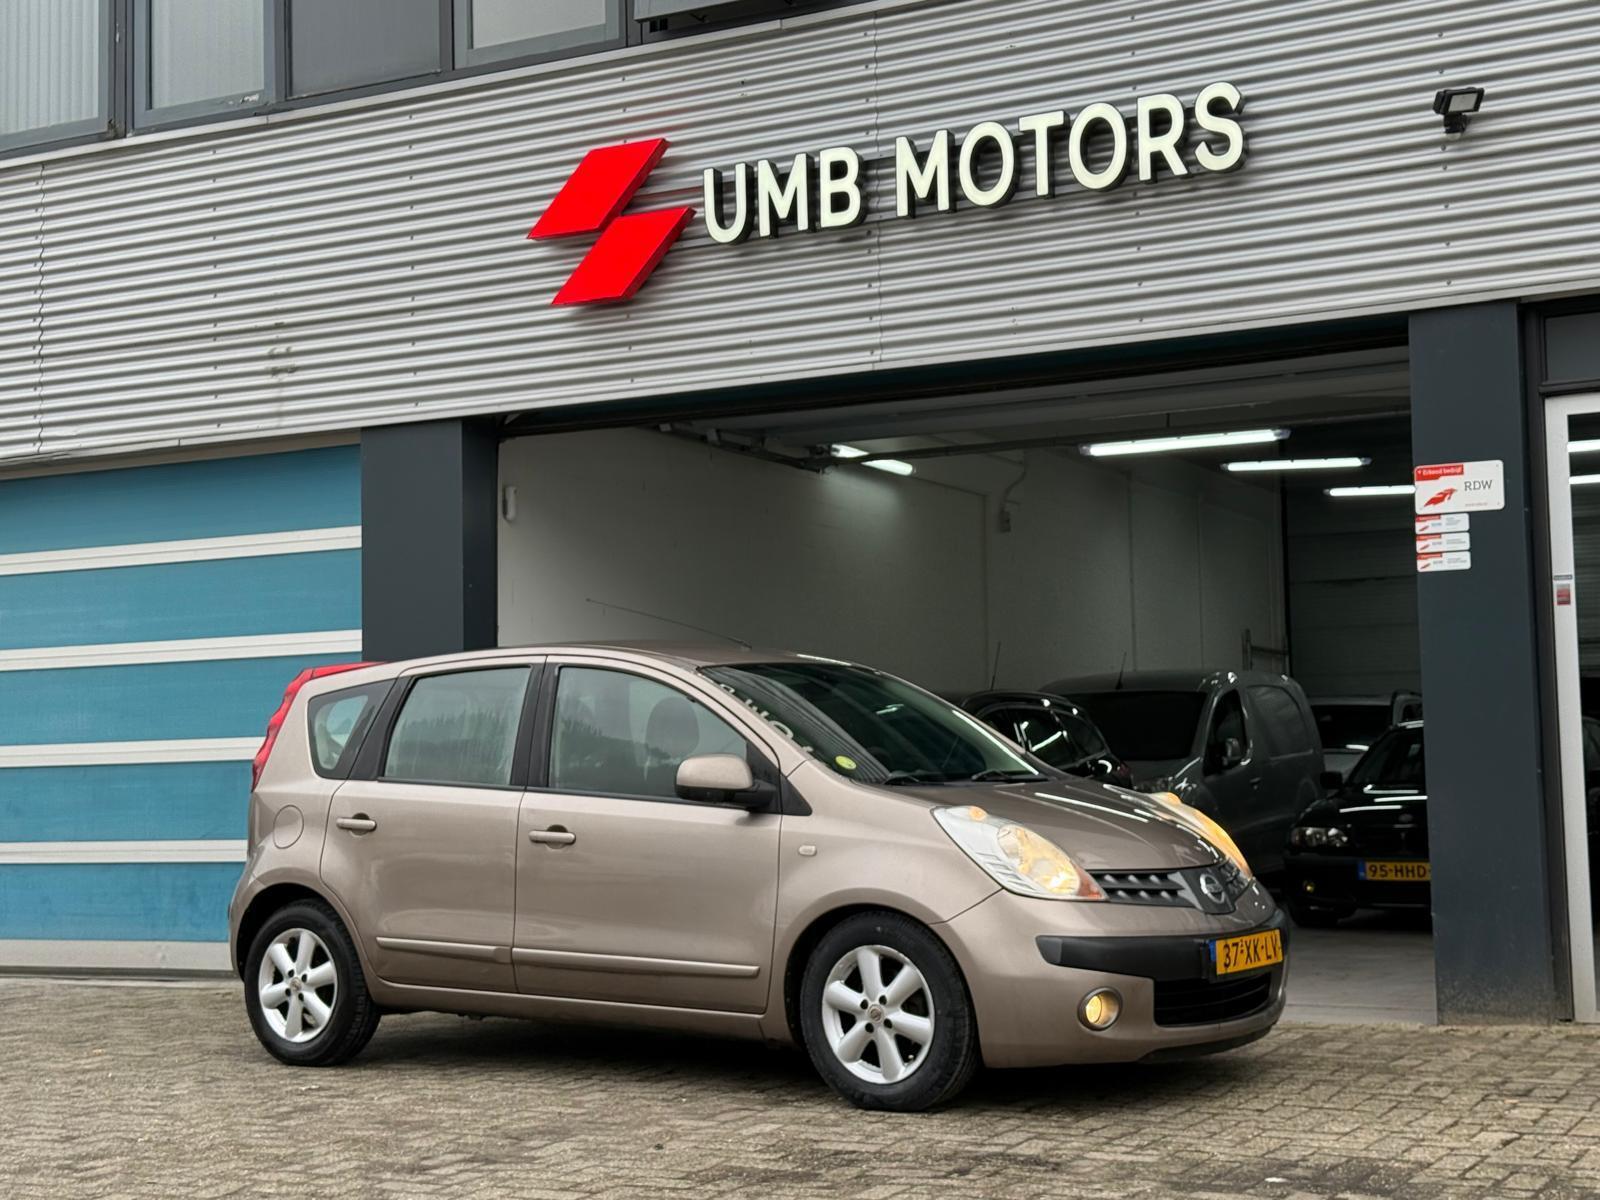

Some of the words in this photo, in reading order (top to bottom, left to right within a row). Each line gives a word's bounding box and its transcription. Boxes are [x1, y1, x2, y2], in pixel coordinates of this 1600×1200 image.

[703, 146, 862, 244] UMB
[895, 81, 1244, 218] MOTORS
[1464, 479, 1493, 492] RDW
